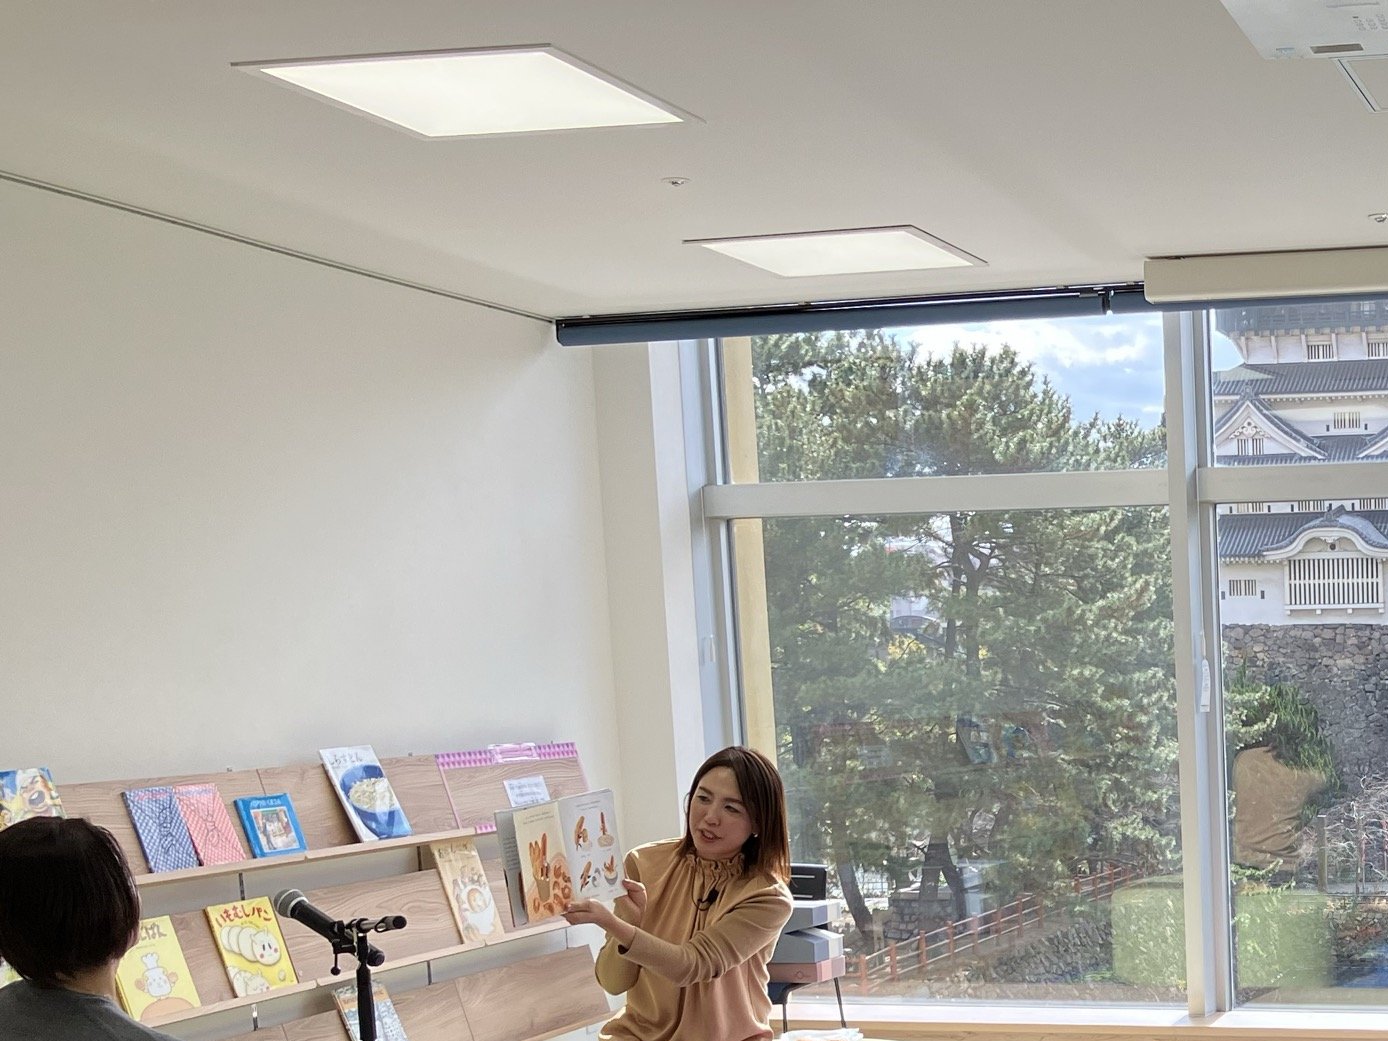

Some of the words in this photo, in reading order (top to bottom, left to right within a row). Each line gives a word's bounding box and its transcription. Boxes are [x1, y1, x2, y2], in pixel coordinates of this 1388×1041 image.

[215, 904, 272, 928] いもむしパン
